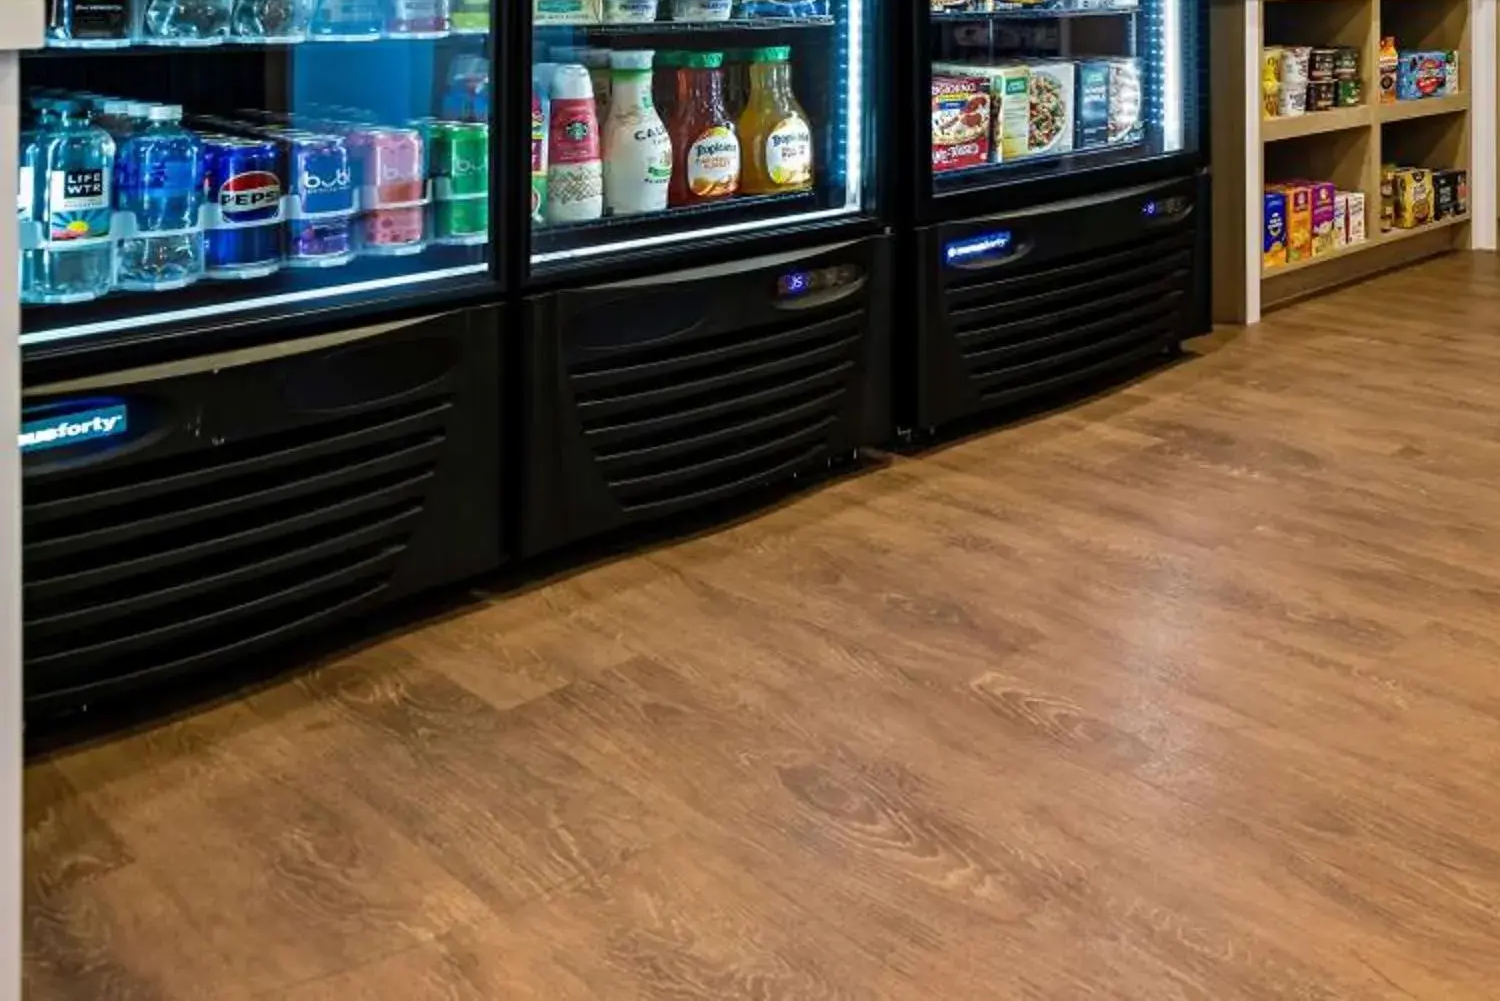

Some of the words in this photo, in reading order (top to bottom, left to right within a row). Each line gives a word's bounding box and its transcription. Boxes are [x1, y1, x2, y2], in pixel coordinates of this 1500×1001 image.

[67, 172, 101, 184] LIFE
[67, 184, 101, 195] WTR
[220, 190, 282, 206] PEPS
